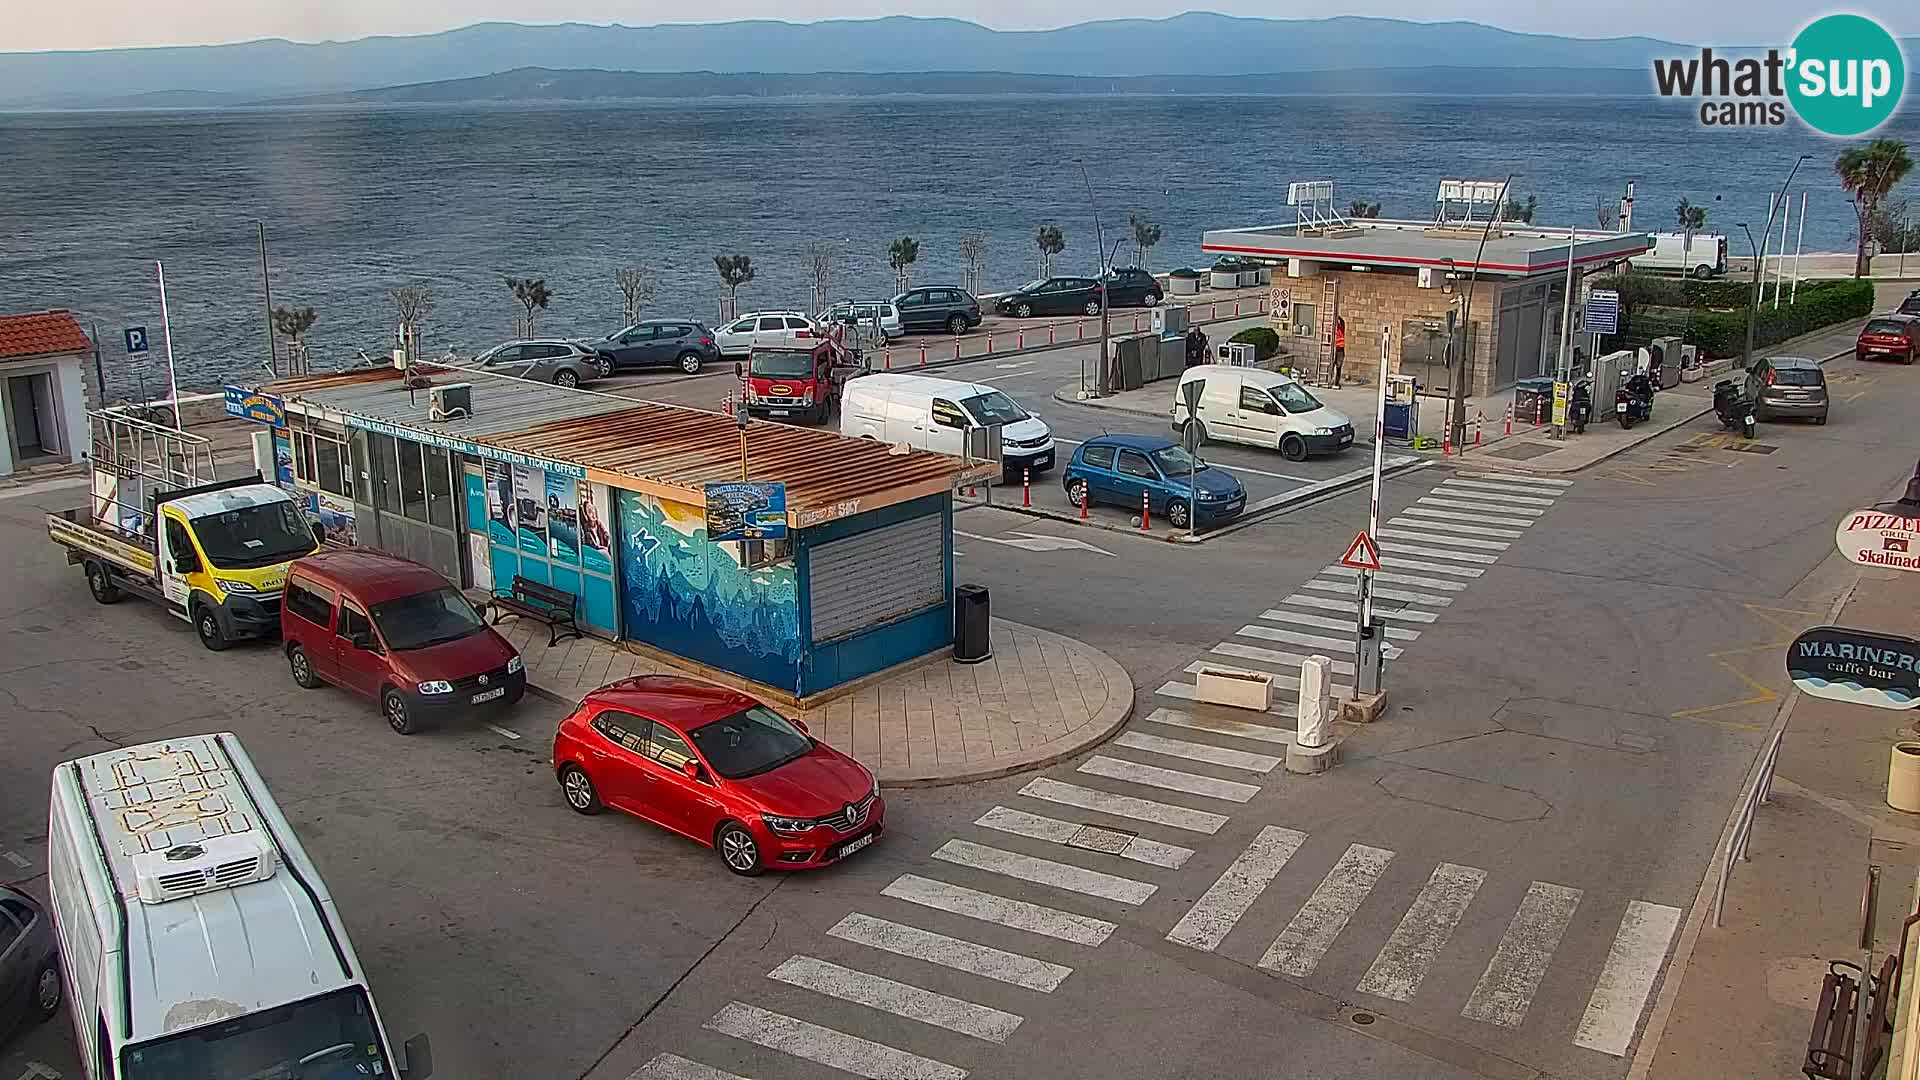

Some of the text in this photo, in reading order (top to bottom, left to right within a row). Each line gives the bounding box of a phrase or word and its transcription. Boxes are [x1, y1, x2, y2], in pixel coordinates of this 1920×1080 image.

[130, 331, 142, 349] P
[395, 426, 435, 444] AUTOBUSNA
[436, 436, 467, 452] POSTAJA
[477, 446, 493, 457] BUS
[493, 449, 526, 465] STATION
[527, 457, 554, 471] TICKET
[554, 462, 582, 477] OFFICE
[1879, 530, 1915, 541] GRILL
[1827, 661, 1896, 680] caffe bar
